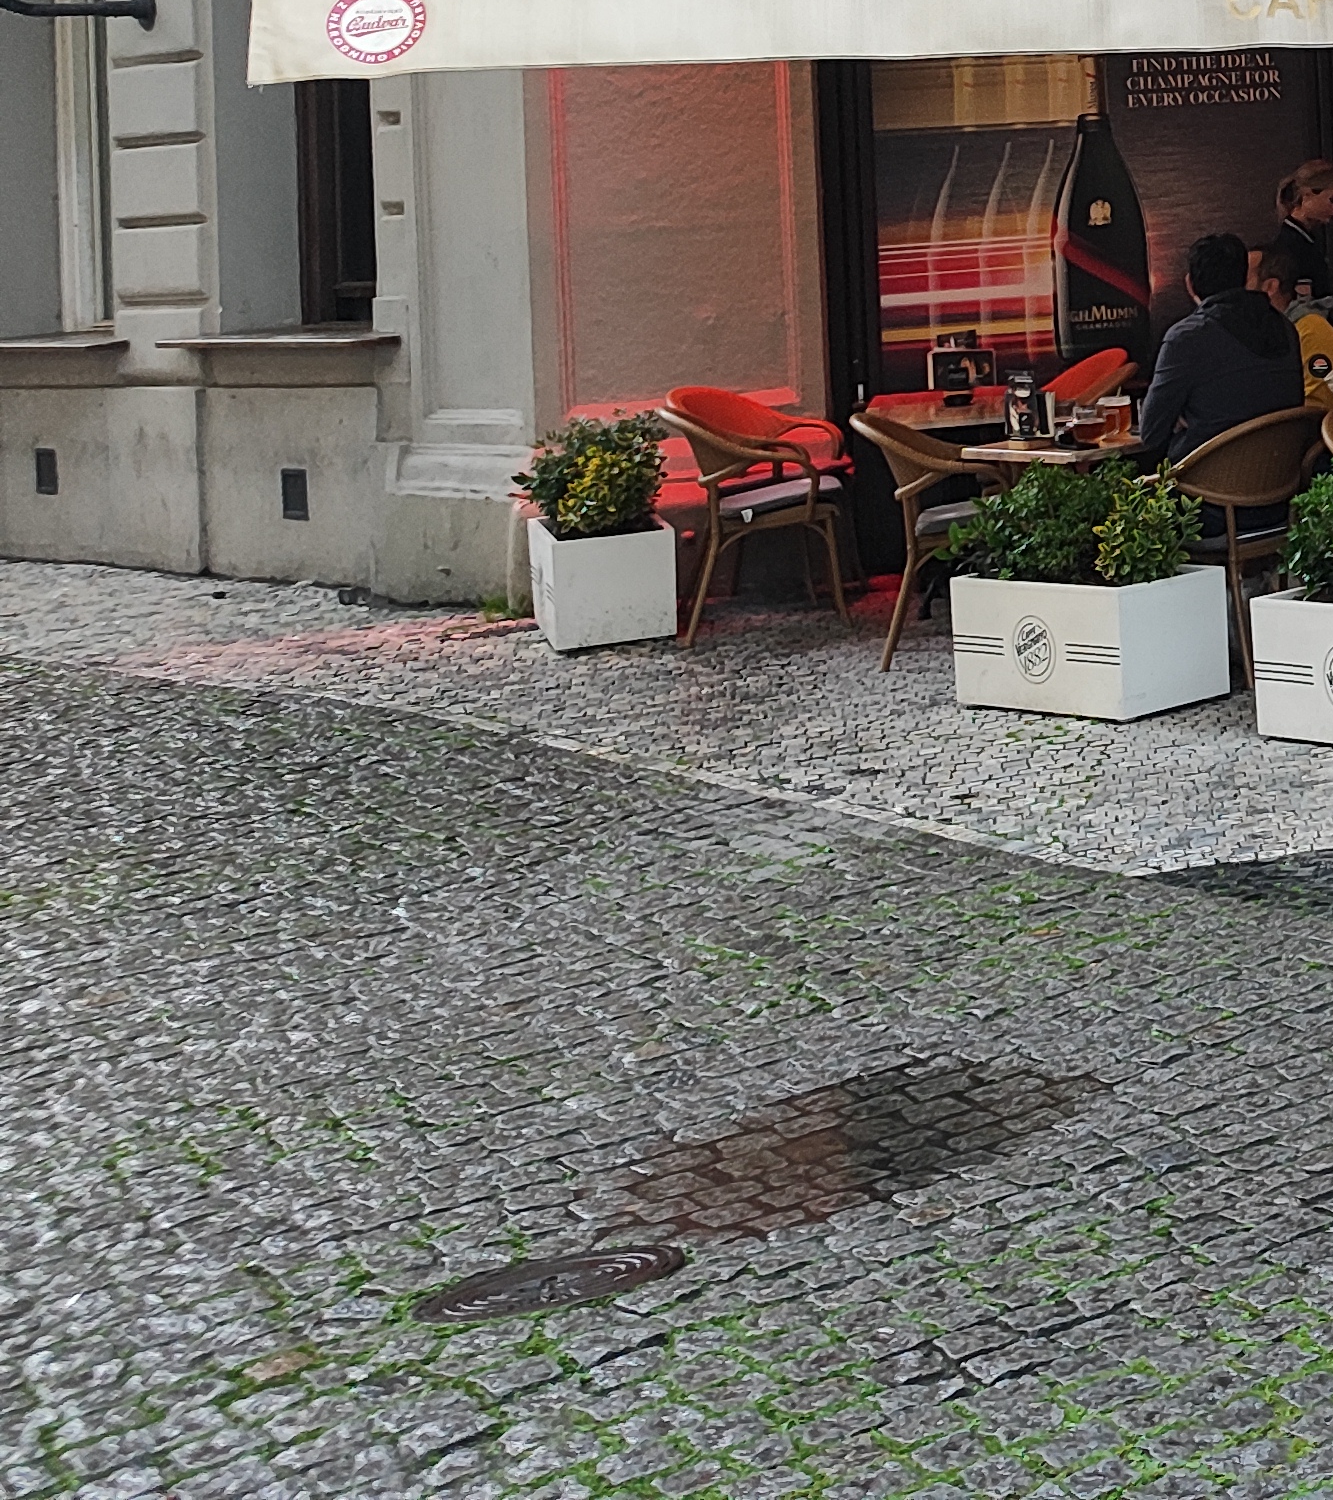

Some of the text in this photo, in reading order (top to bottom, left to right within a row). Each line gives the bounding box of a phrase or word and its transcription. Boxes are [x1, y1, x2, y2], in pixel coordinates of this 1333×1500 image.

[1132, 52, 1275, 73] FIND THE IDEAL
[1126, 69, 1281, 90] CHAMPAGNE FOR
[1127, 86, 1281, 108] EVERY OCCASION
